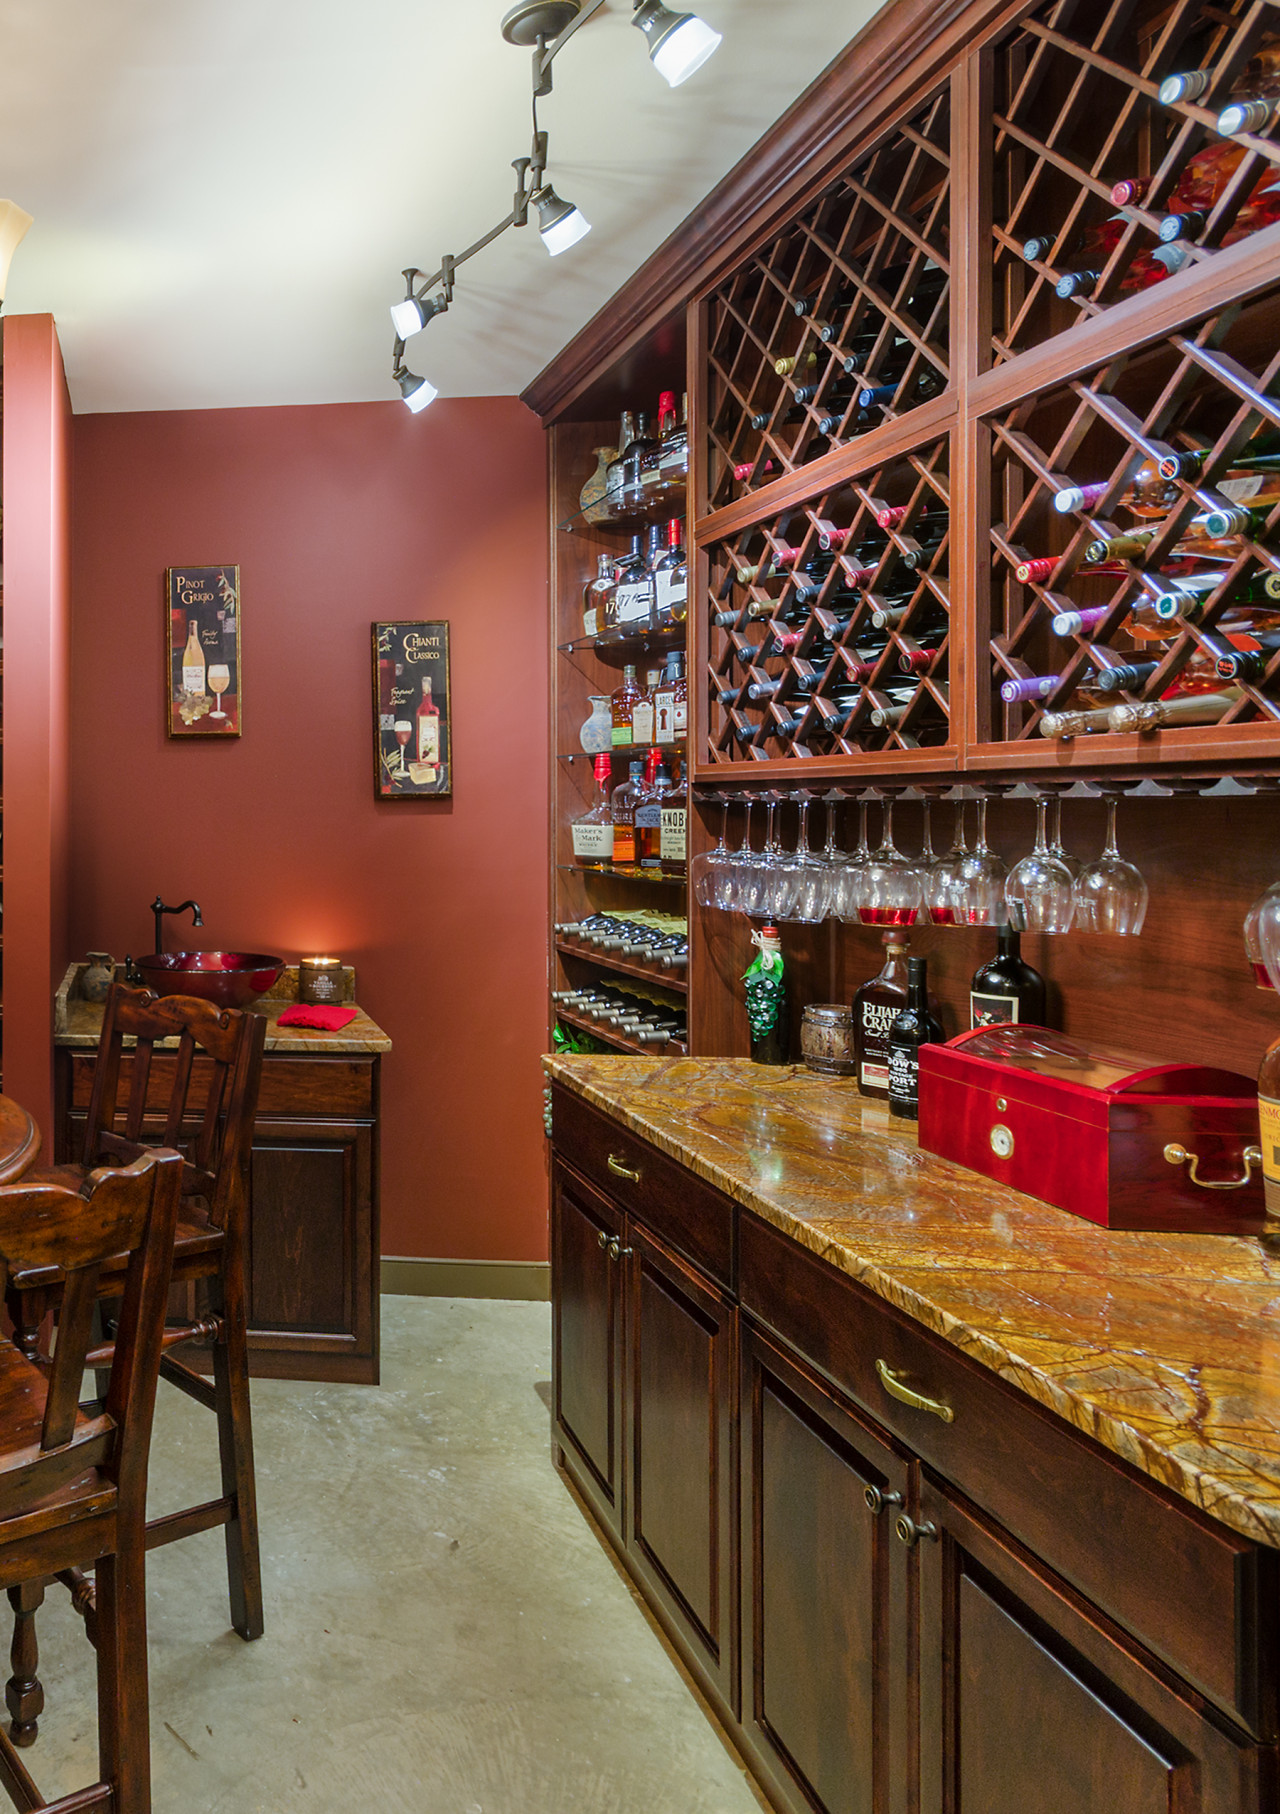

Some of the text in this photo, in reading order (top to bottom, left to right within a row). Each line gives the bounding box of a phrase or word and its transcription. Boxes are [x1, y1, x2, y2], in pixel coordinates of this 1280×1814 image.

[176, 576, 205, 593] PINOT
[181, 590, 214, 605] GRIGIO
[403, 632, 440, 651] CHIANTI
[405, 648, 440, 664] CLASSICO
[662, 811, 684, 827] KNOB
